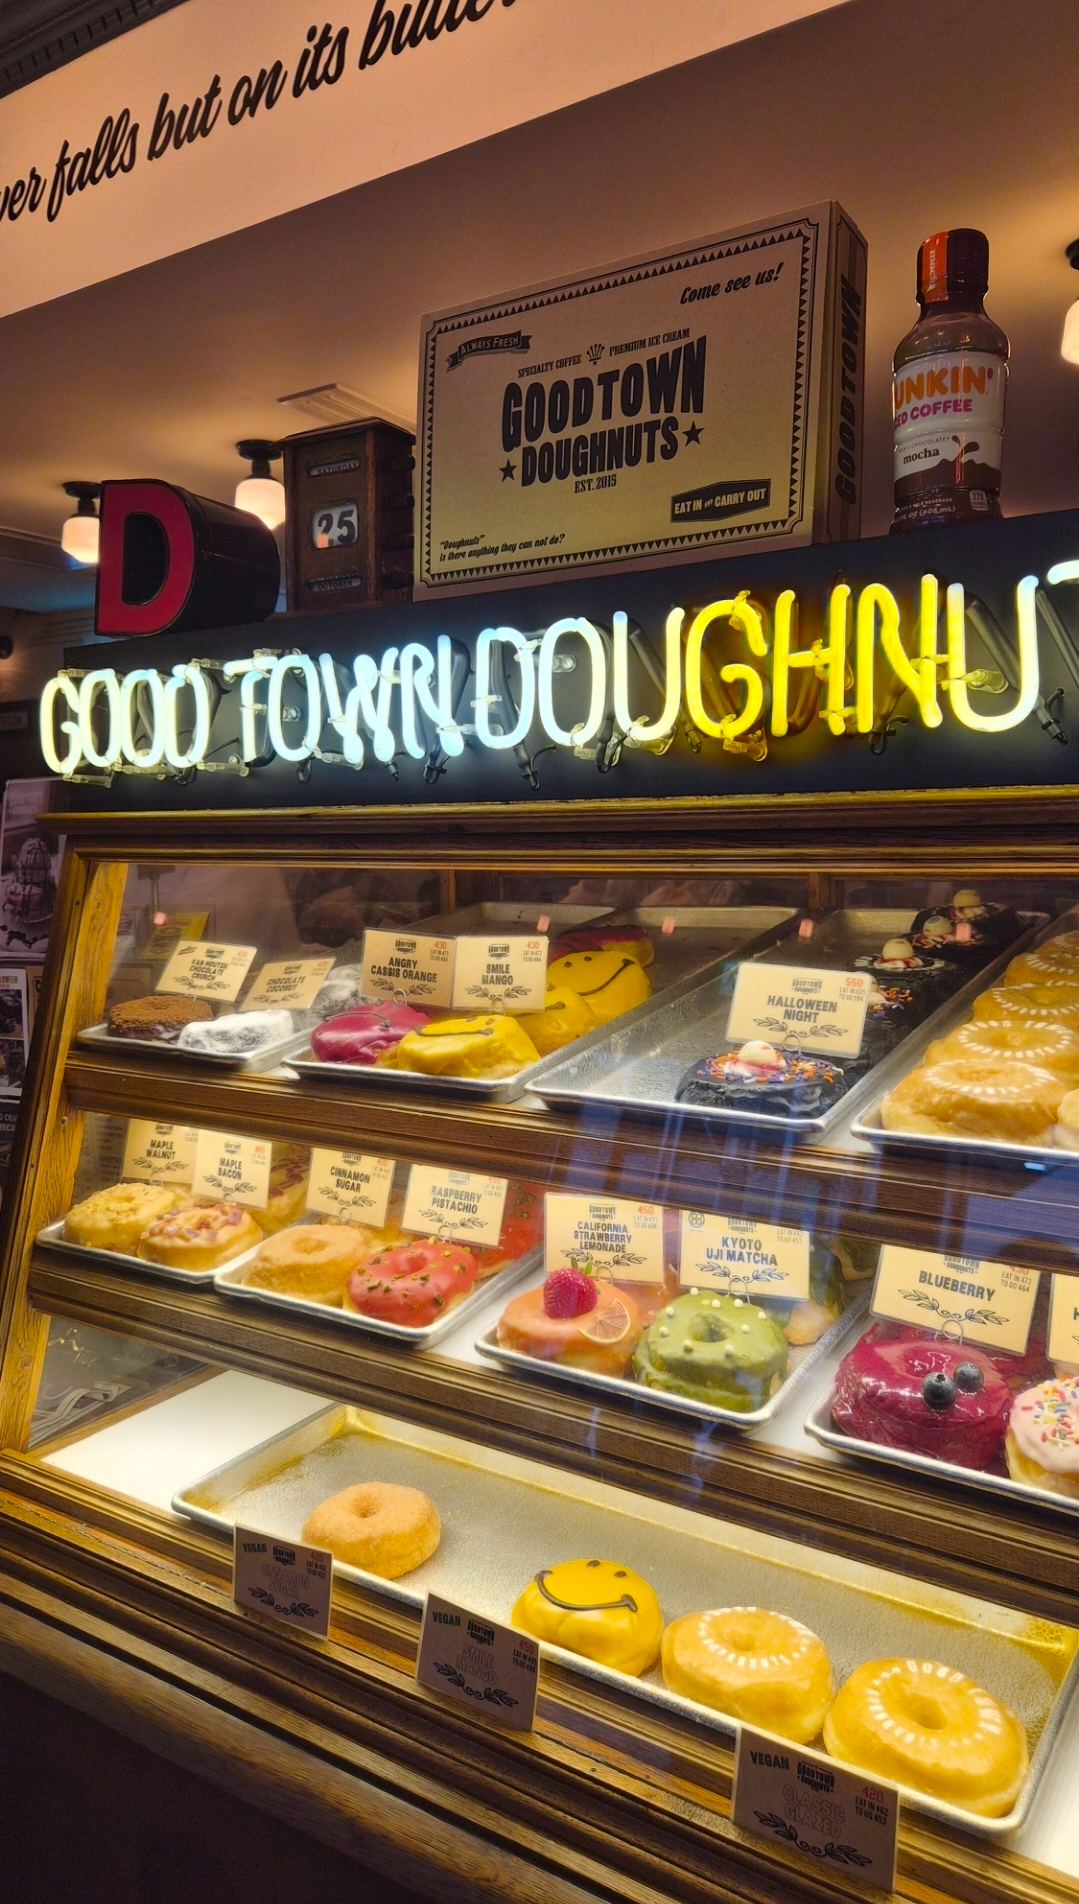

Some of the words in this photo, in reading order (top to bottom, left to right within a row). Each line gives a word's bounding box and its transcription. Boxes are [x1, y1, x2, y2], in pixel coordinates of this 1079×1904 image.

[47, 107, 140, 222] falls
[147, 73, 224, 162] but
[227, 59, 288, 126] on
[292, 22, 350, 98] its
[680, 285, 720, 305] Come
[724, 275, 752, 293] see
[754, 261, 785, 287] us!
[517, 361, 554, 379] SPECIALTY
[555, 354, 582, 369] COFFEE
[609, 338, 646, 356] PREMIUM
[648, 335, 662, 347] ICE
[663, 327, 690, 344] CREAM
[501, 334, 707, 453] GOODTOWN
[834, 273, 863, 505] GOODTOWN
[910, 398, 973, 421] COFFEE
[520, 415, 680, 487] DOUGHNUTS
[902, 447, 941, 465] mocha
[317, 463, 359, 475] SATURDAY
[573, 478, 596, 494] EST.
[596, 473, 618, 489] 2015
[674, 500, 692, 515] EAT
[692, 499, 703, 511] IN
[714, 491, 746, 508] CARRY
[746, 487, 767, 502] OUT
[317, 509, 356, 545] 25
[447, 550, 467, 561] there
[467, 545, 500, 559] anything
[500, 541, 518, 553] they
[518, 540, 533, 549] can
[534, 536, 549, 548] not
[549, 533, 566, 545] do?
[95, 480, 197, 637] D
[317, 579, 353, 590] OCTOBER
[40, 664, 210, 774] GOOD
[222, 634, 465, 765] TOWN
[434, 941, 448, 950] 430
[189, 965, 225, 976] CHOCOLATE
[205, 960, 228, 969] HOUTEN
[388, 957, 418, 969] ANGRY
[485, 963, 510, 974] SMILE
[191, 972, 217, 982] CRUNCH
[267, 976, 307, 986] CHOCOLATE
[370, 965, 401, 978] CASSIS
[402, 969, 437, 983] ORANGE
[481, 974, 514, 985] MANGO
[845, 977, 864, 988] 550
[266, 984, 298, 993] COCONUT
[766, 994, 838, 1013] HALLOWEEN
[783, 1008, 820, 1023] NIGHT
[150, 1139, 175, 1150] MAPLE
[146, 1148, 176, 1160] WALNUT
[219, 1157, 243, 1170] MAPLE
[218, 1167, 243, 1180] BACON
[330, 1165, 371, 1184] CINNAMON
[335, 1179, 361, 1194] SUGAR
[430, 1185, 483, 1204] RASPBERRY
[431, 1196, 478, 1215] PISTACHIO
[638, 1205, 654, 1215] 450
[577, 1220, 629, 1234] CALIFORNIA
[776, 1228, 787, 1236] EAT
[573, 1230, 632, 1244] STRAWBERRY
[721, 1236, 763, 1251] KYOTO
[579, 1241, 626, 1254] LEMONADE
[706, 1247, 724, 1261] UJI
[725, 1250, 778, 1266] MATCHA
[917, 1270, 996, 1302] BLUEBERRY
[1000, 1279, 1008, 1287] TO
[1008, 1281, 1018, 1290] GO
[1018, 1284, 1030, 1293] 464
[1001, 1271, 1012, 1280] EAT
[1013, 1274, 1020, 1282] IN
[1020, 1276, 1032, 1286] 473
[242, 1543, 268, 1553] VEGAN
[260, 1562, 310, 1590] CINNAMON
[269, 1579, 300, 1599] SUGAR
[432, 1611, 462, 1627] VEGAN
[462, 1643, 495, 1669] SMILE
[518, 1640, 534, 1655] 450
[456, 1655, 497, 1686] MANGO
[749, 1750, 790, 1770] VEGAN
[797, 1761, 836, 1789] GOODTOWN
[782, 1783, 846, 1824] CLASSIC
[862, 1785, 884, 1804] 420
[855, 1796, 867, 1807] EAT
[867, 1800, 875, 1811] IN
[875, 1803, 889, 1817] 462
[855, 1805, 864, 1816] TO
[863, 1809, 873, 1820] GO
[873, 1813, 887, 1826] 453
[784, 1801, 842, 1839] GLAZED
